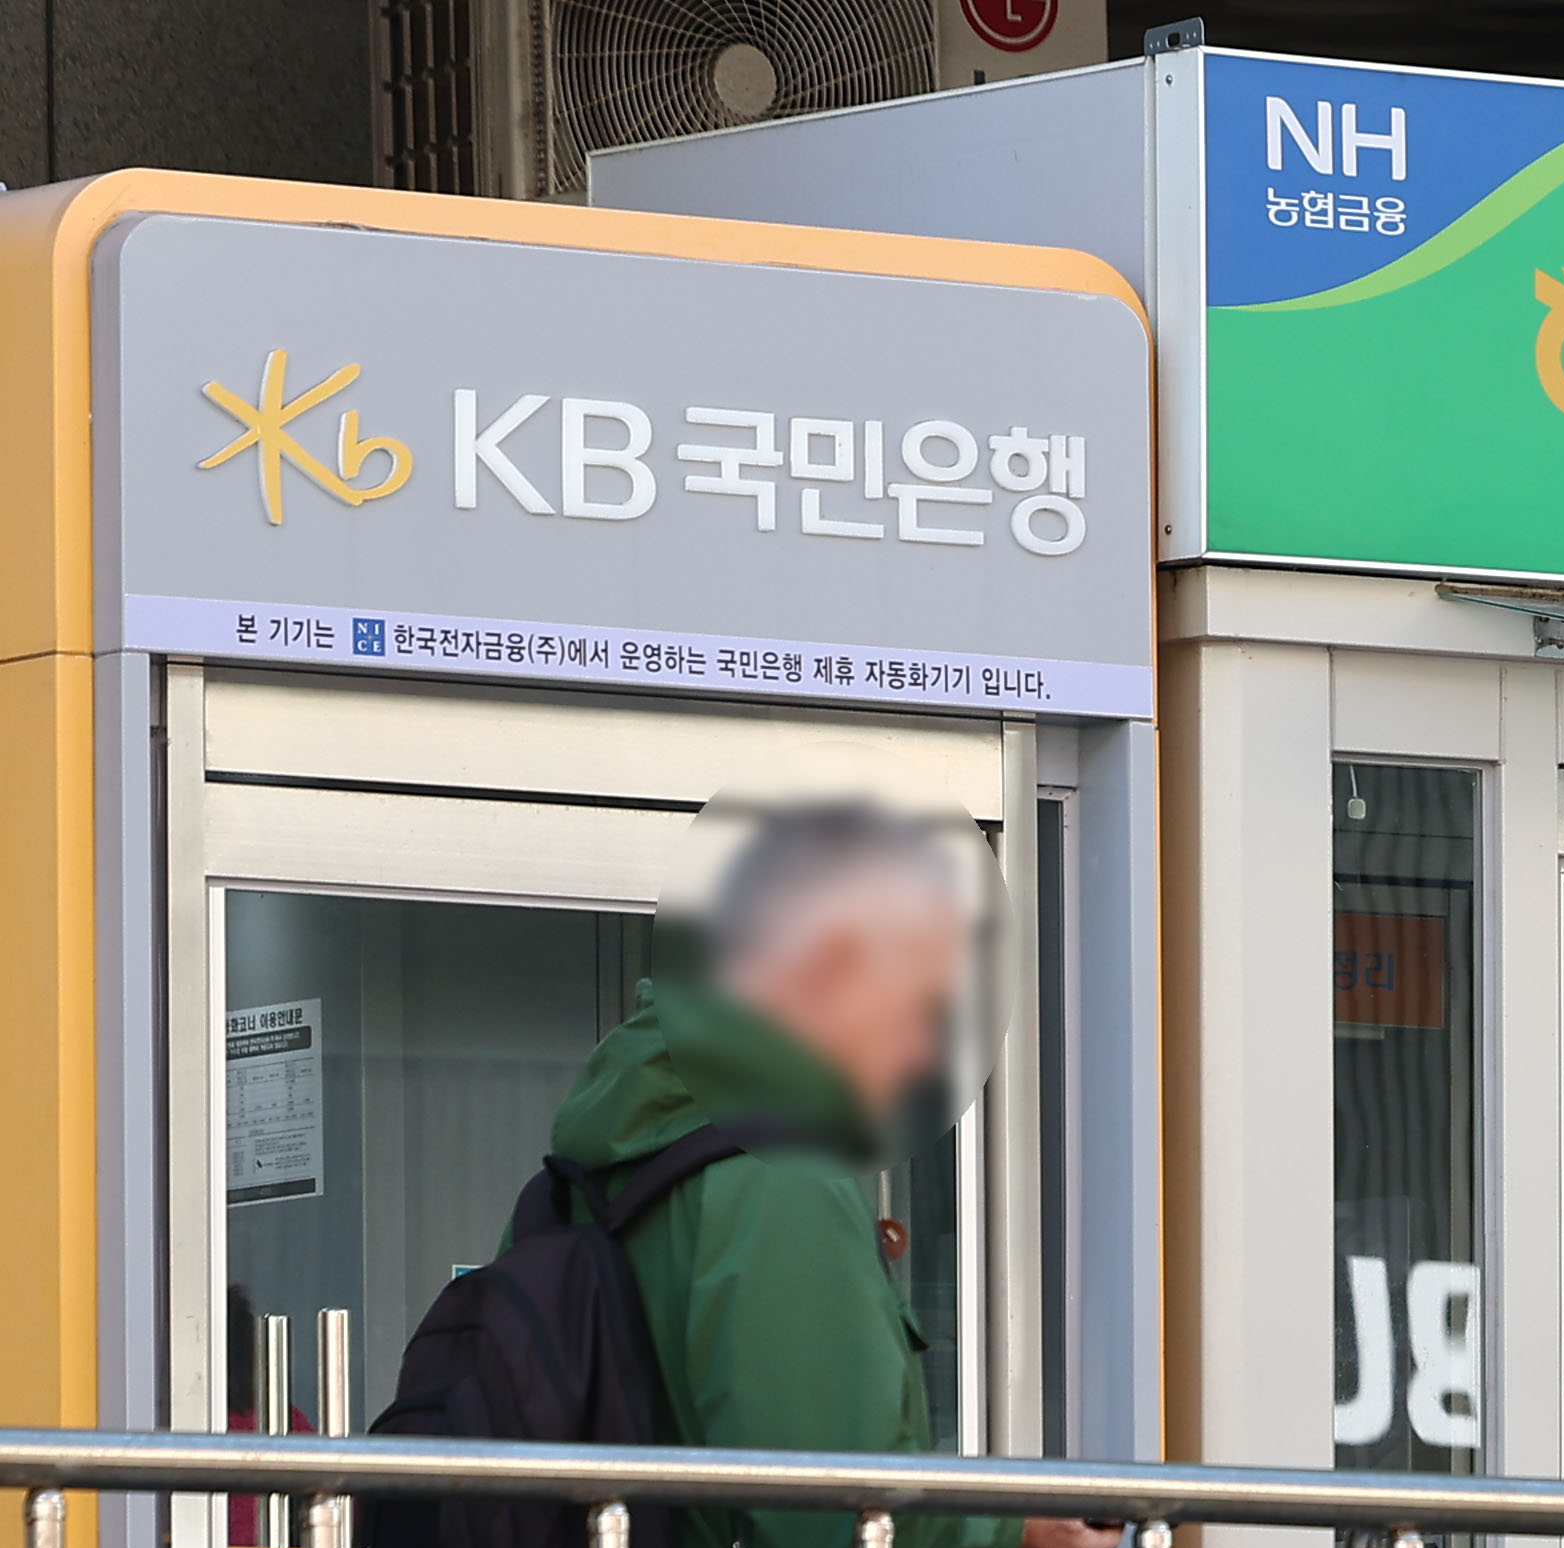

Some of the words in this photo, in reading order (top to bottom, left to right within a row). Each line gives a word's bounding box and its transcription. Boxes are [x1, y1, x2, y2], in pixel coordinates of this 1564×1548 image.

[1264, 95, 1407, 181] NH
[1264, 189, 1408, 236] 농협금융
[235, 613, 258, 644] 본
[269, 616, 335, 650] 기기는
[619, 640, 707, 676] 운영하는
[716, 648, 802, 683] 국민은행
[813, 654, 856, 687] 제휴
[865, 658, 972, 695] 자동화기기
[981, 666, 1052, 701] 입니다.
